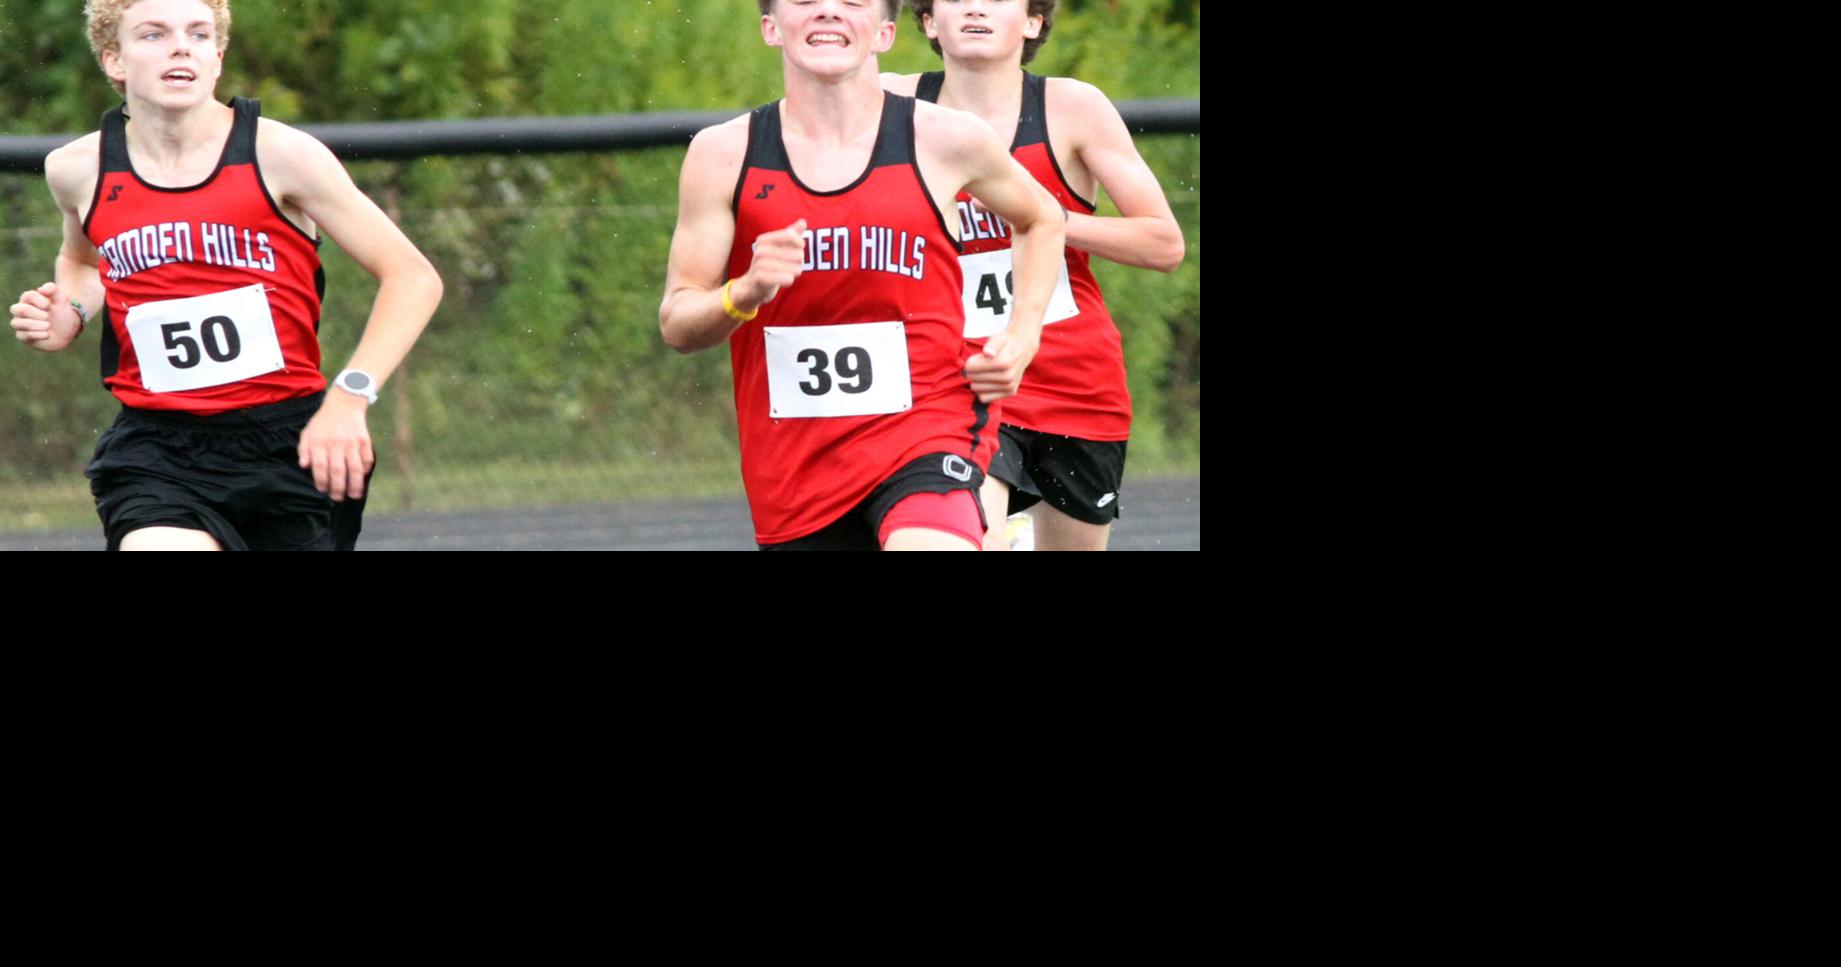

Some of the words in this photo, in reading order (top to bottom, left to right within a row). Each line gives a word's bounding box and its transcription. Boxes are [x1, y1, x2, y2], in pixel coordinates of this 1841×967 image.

[956, 200, 1006, 242] DEN
[98, 220, 195, 283] AMDEN
[200, 221, 276, 273] HILLS
[799, 226, 850, 272] DEN
[859, 225, 927, 281] HILLS
[975, 270, 1013, 316] 4
[160, 314, 242, 370] 50
[796, 346, 874, 397] 39
